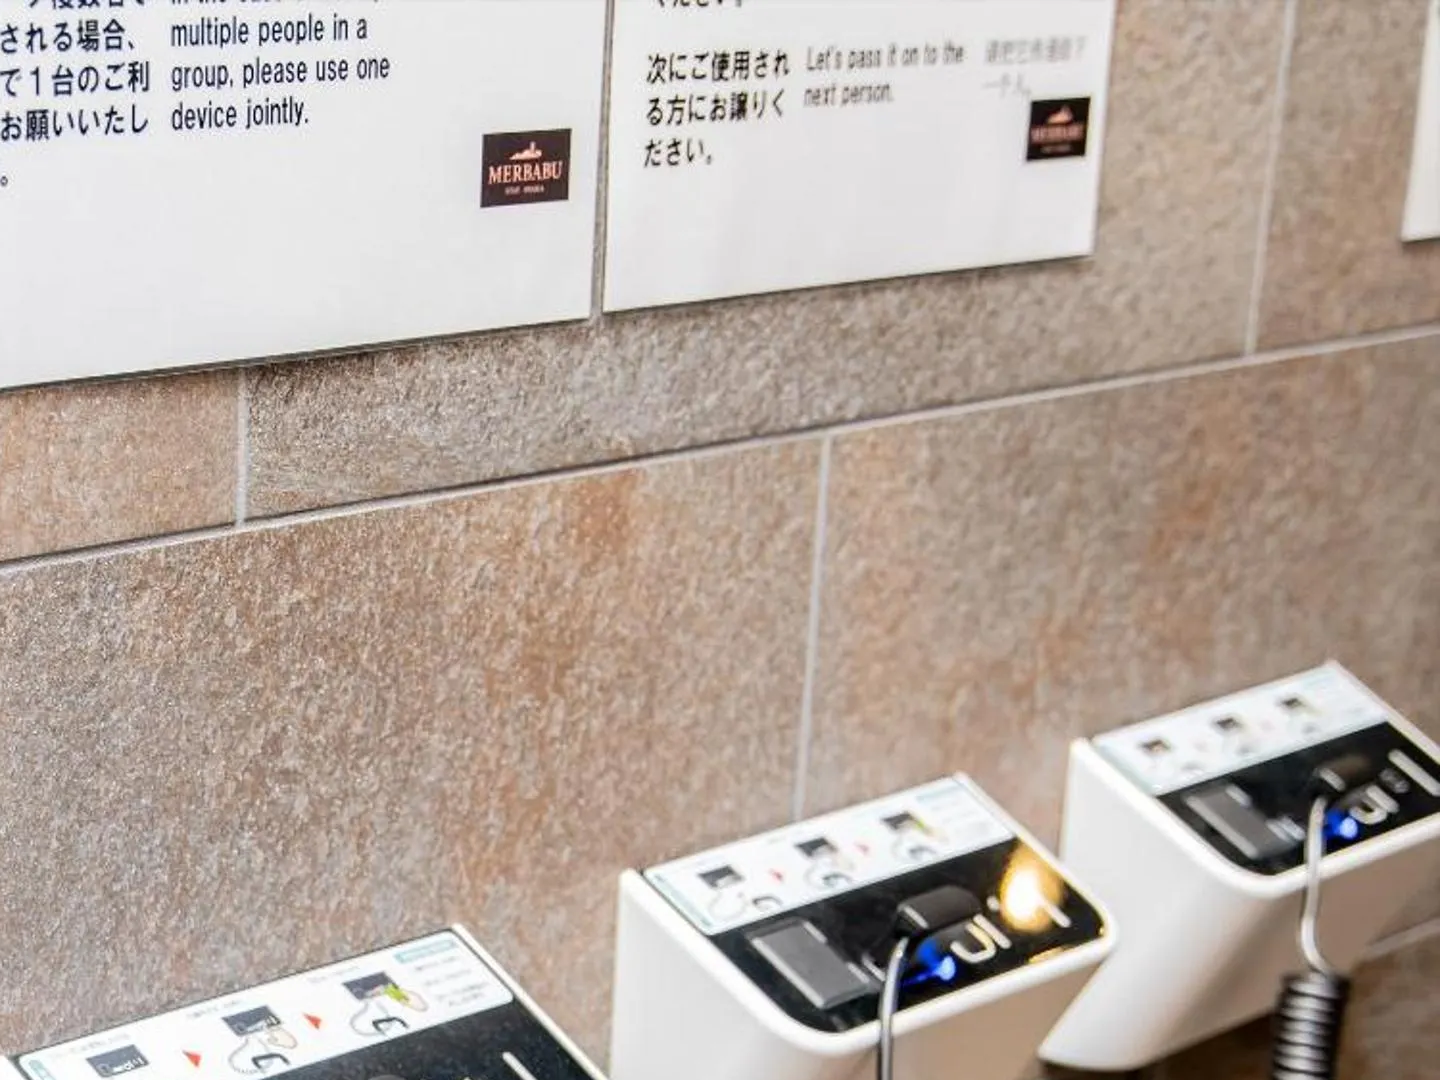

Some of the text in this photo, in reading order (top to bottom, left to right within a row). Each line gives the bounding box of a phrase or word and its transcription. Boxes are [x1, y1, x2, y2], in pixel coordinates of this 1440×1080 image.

[171, 13, 368, 48] multiple people in a
[646, 49, 789, 84] 次にご使用され
[847, 47, 881, 69] pass
[901, 47, 919, 67] on
[942, 38, 964, 63] the
[172, 56, 390, 91] group, please use one
[646, 88, 786, 126] る方にお譲りく
[803, 81, 837, 107] next
[171, 96, 309, 131] device jointly.
[644, 137, 714, 168] ださい。
[488, 160, 563, 185] MERBABU
